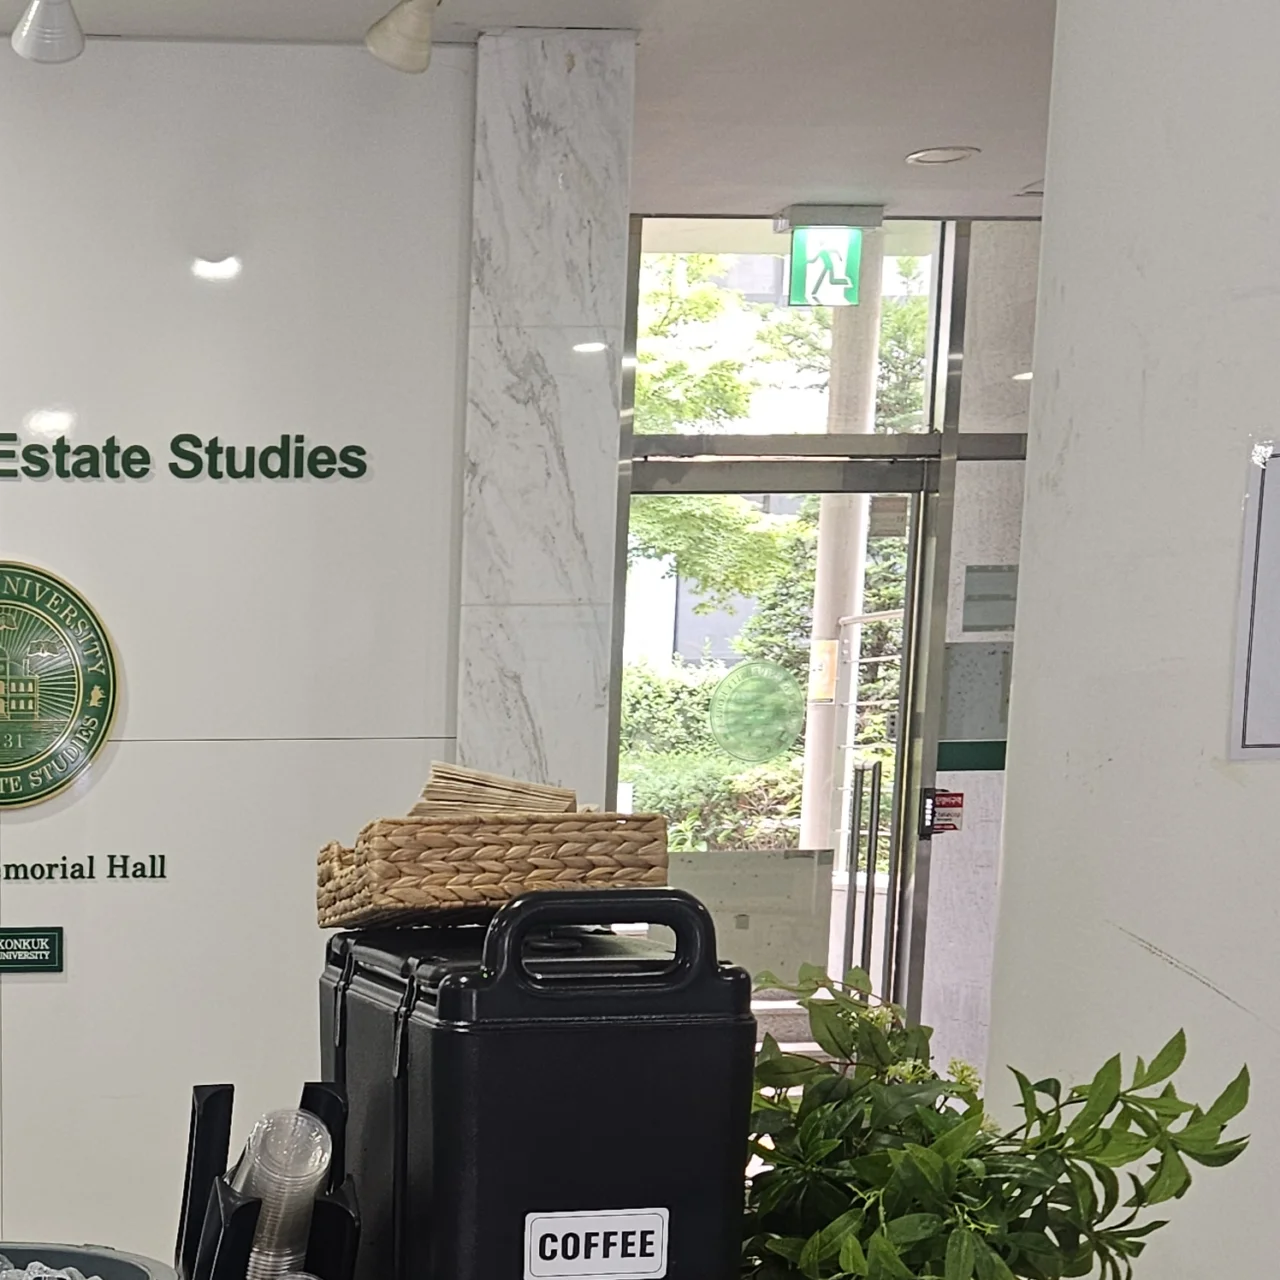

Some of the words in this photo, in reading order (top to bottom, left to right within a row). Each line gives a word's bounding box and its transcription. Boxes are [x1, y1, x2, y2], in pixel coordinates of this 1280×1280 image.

[168, 433, 367, 479] Studies
[28, 715, 99, 789] STUDIES
[107, 854, 167, 879] Hall
[538, 1230, 655, 1261] COFFEE
